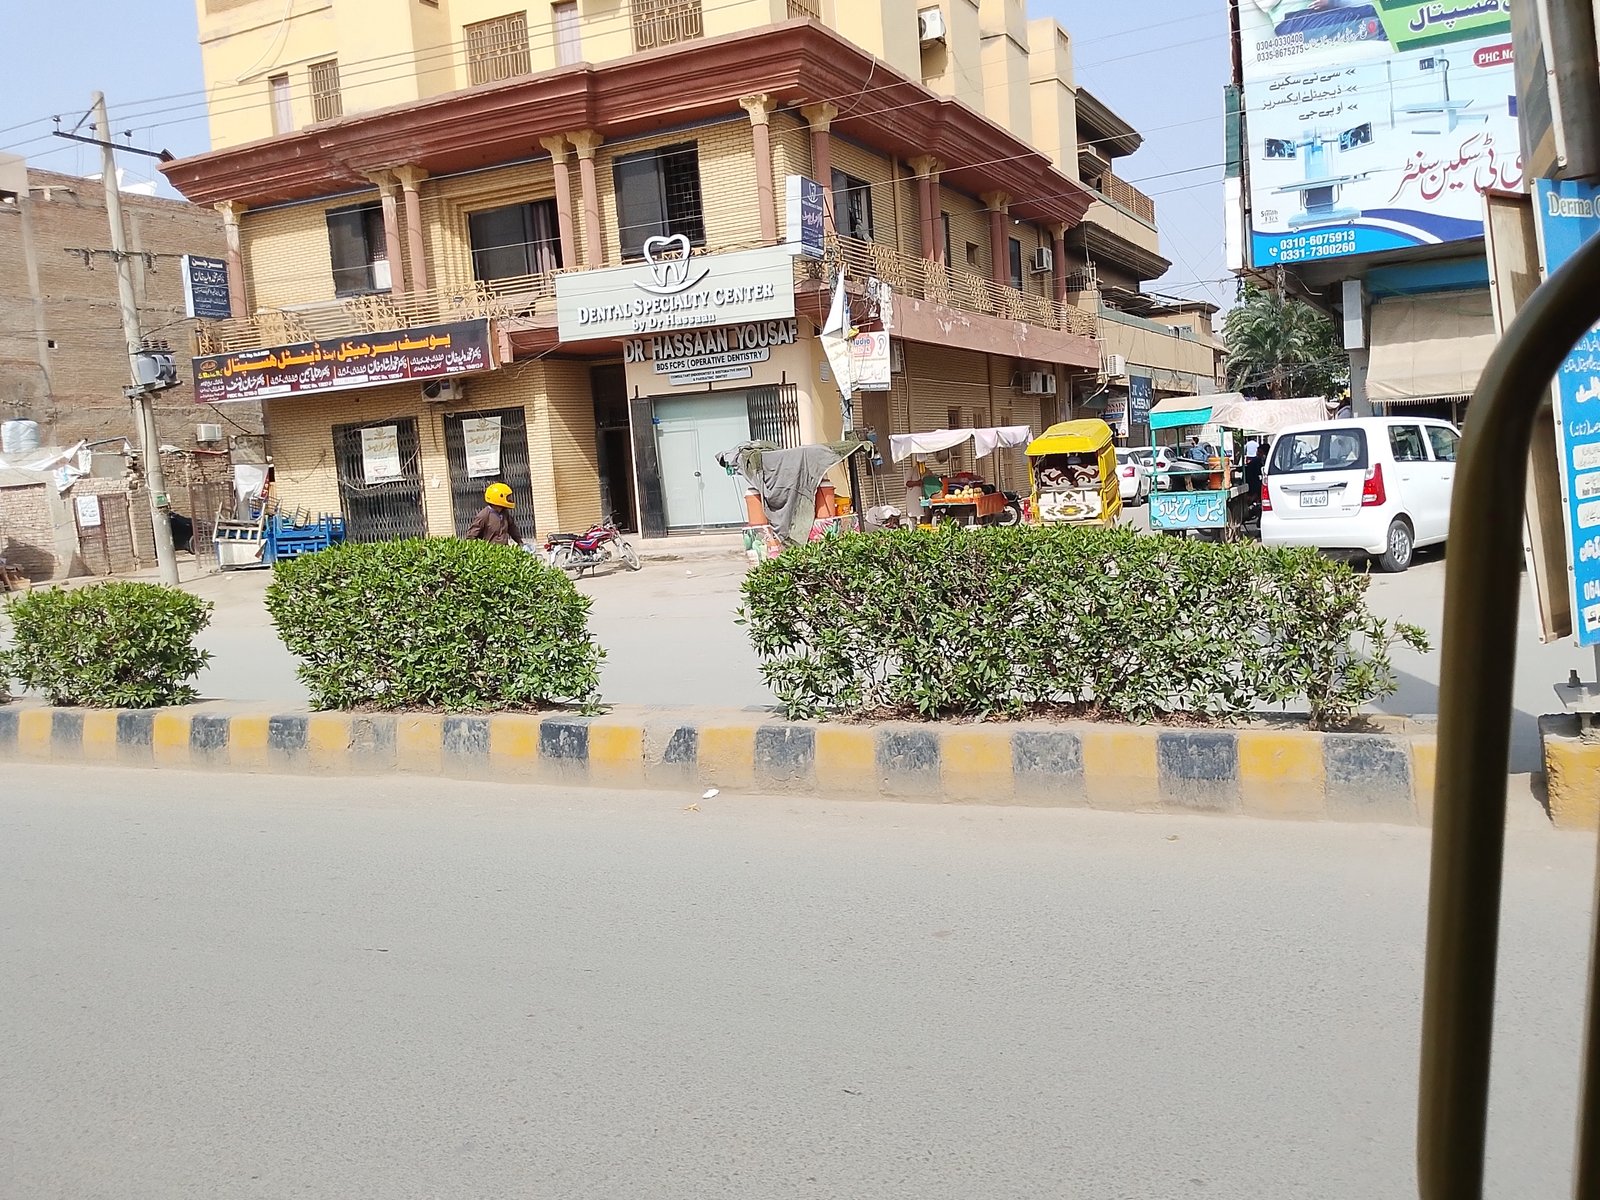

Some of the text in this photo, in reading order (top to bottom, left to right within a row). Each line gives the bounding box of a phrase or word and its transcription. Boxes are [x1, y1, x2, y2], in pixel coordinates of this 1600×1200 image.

[1257, 44, 1304, 62] 0335-8675275
[1478, 51, 1500, 64] PHC
[1421, 132, 1481, 200] سکین
[1547, 192, 1594, 218] Derma
[1280, 230, 1355, 250] 0310-6075913
[1280, 242, 1356, 261] 0331-7300260
[577, 283, 775, 325] DENTAL SPECIALTY CENTER
[632, 312, 717, 332] by Dr Hassaan
[337, 340, 398, 362] سرجیکل
[399, 333, 451, 351] یوسف
[624, 339, 646, 363] DR
[651, 328, 729, 361] HASSAAN
[735, 319, 799, 351] YOUSAF
[277, 343, 322, 369] ڈینٹل
[656, 362, 669, 371] BDS
[669, 360, 686, 370] FCPS
[727, 350, 763, 363] DENTISTRY
